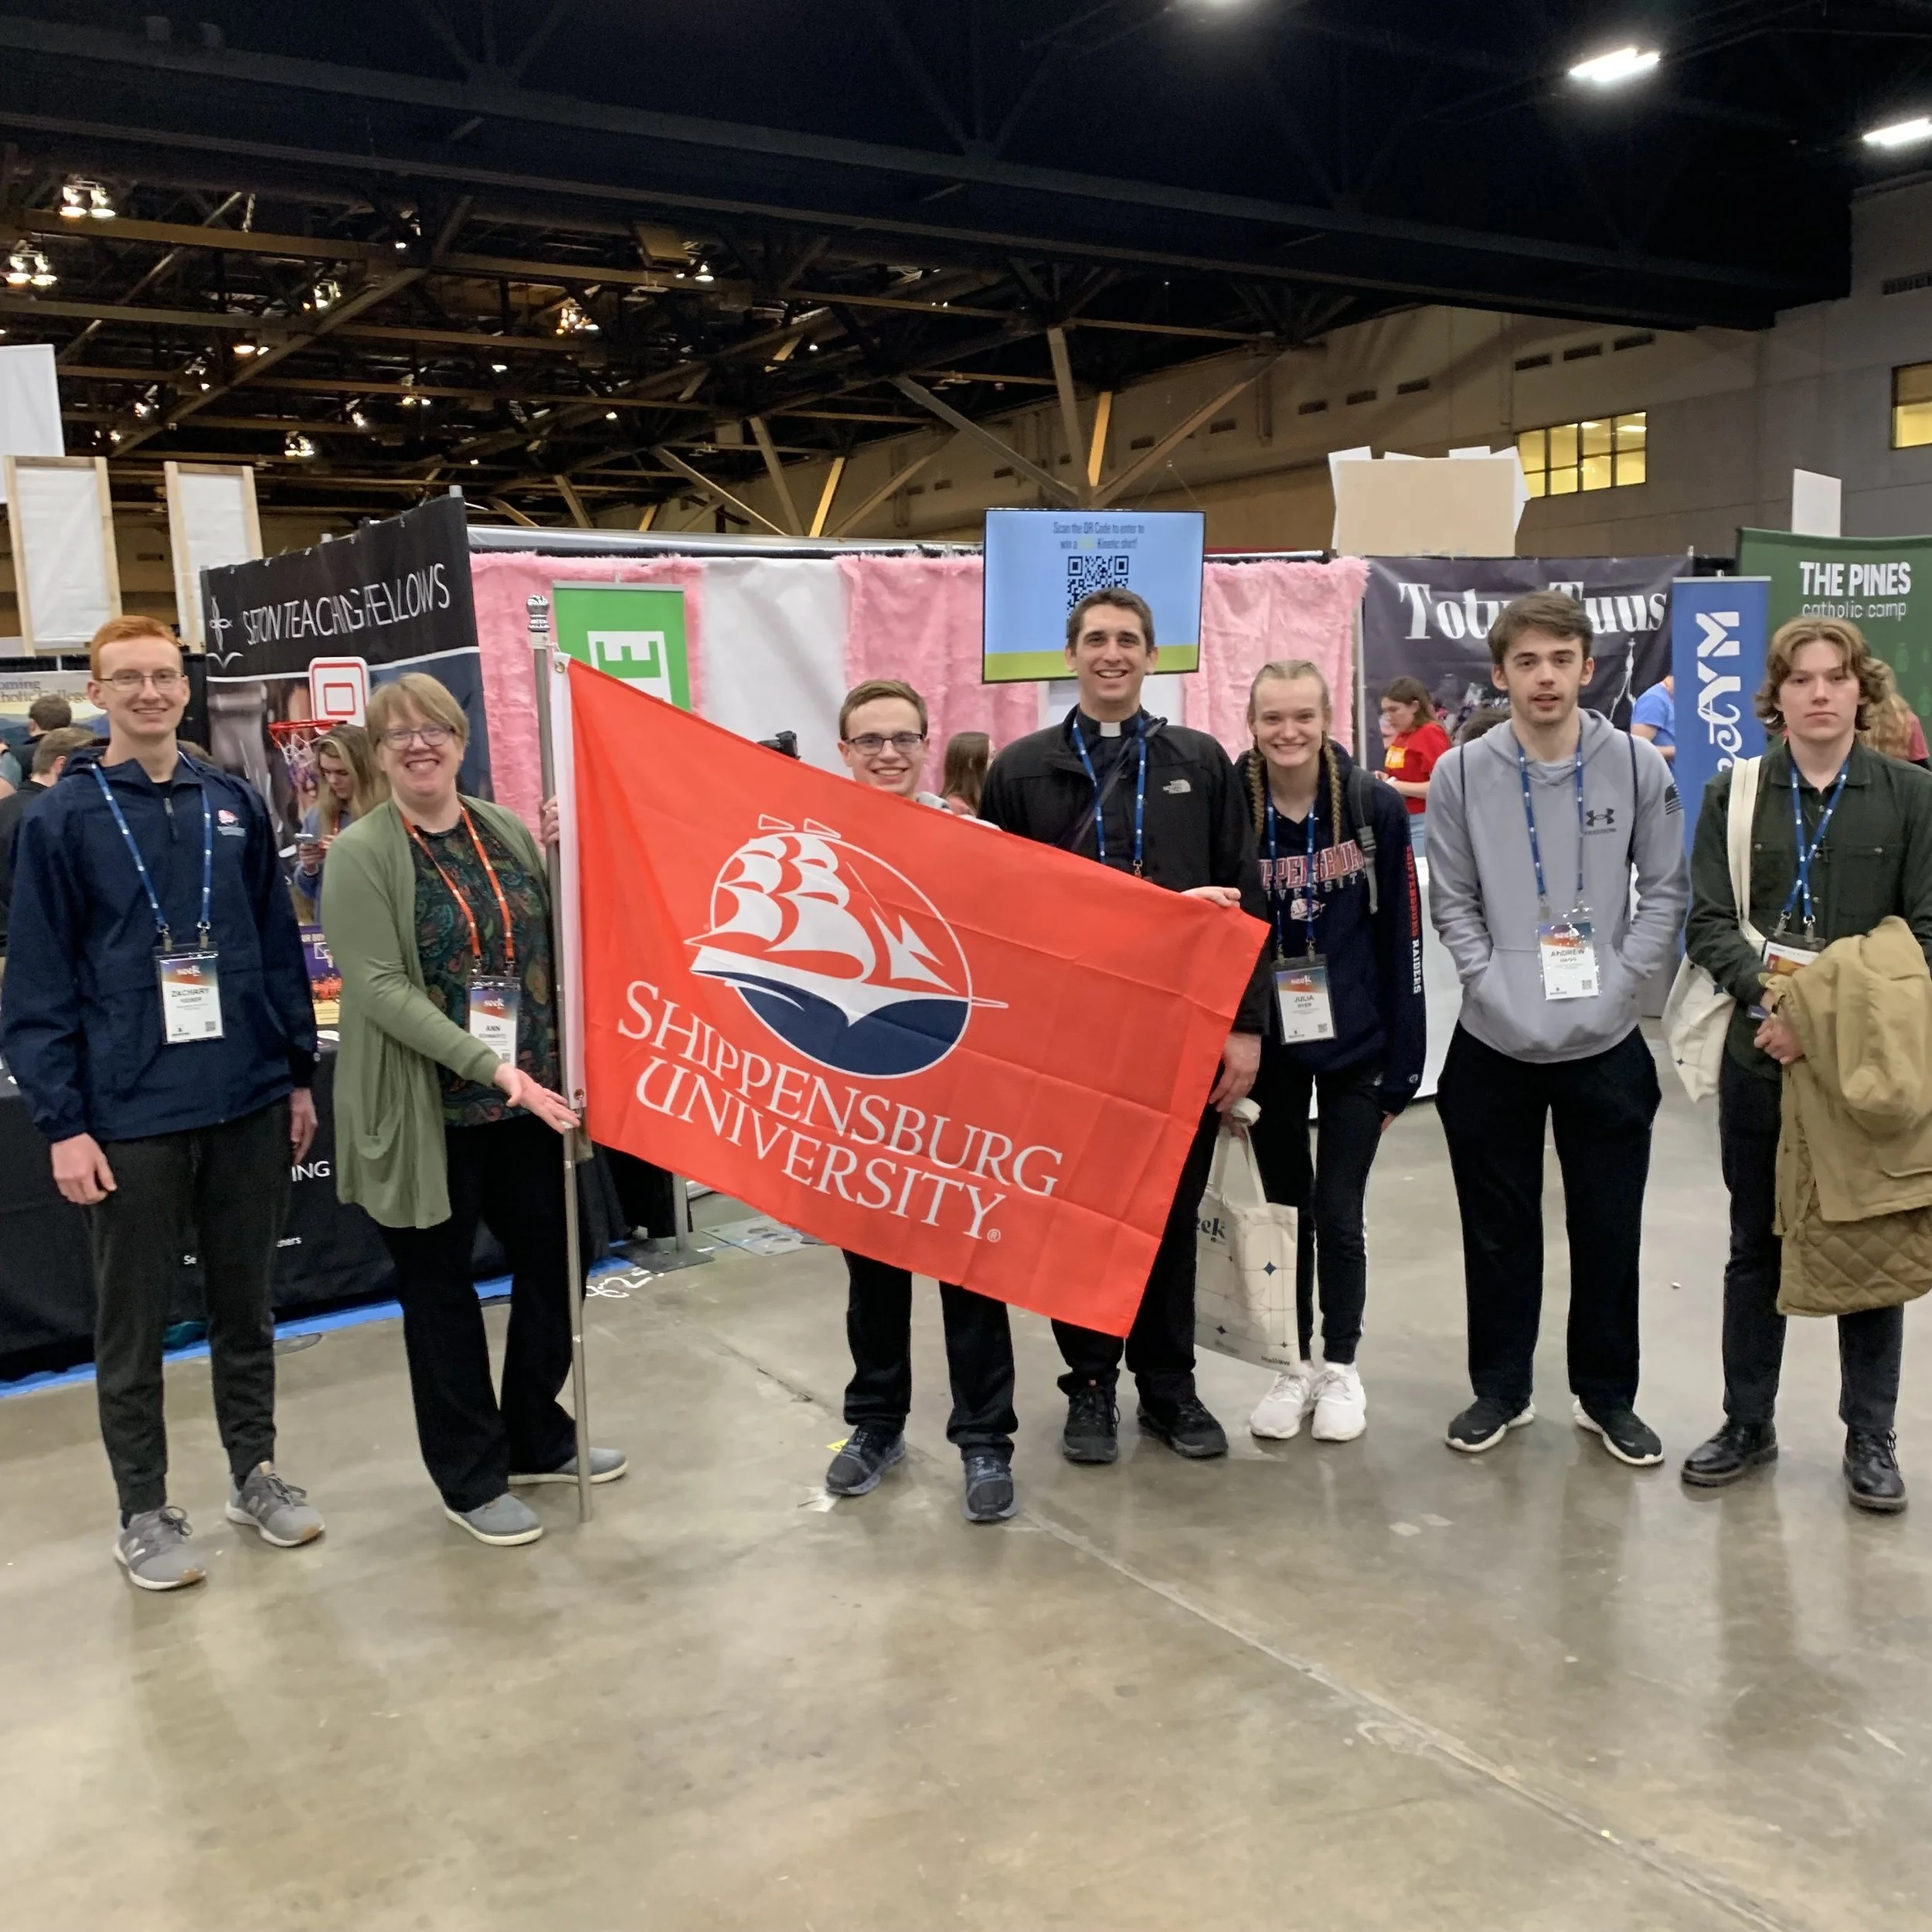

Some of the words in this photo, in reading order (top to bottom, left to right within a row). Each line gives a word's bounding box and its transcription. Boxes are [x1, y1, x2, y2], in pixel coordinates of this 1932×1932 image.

[243, 604, 281, 645] SETON
[284, 588, 366, 639] TEACHING
[364, 563, 451, 628] FELLOWS
[1799, 561, 1845, 597] THE
[1848, 561, 1912, 597] PINES
[1802, 600, 1862, 619] catholic
[1868, 602, 1906, 621] camp
[1412, 938, 1423, 994] RAIDERS
[617, 980, 1063, 1197] SHIPPENSBURG
[635, 1056, 1006, 1240] UNIVERSITY
